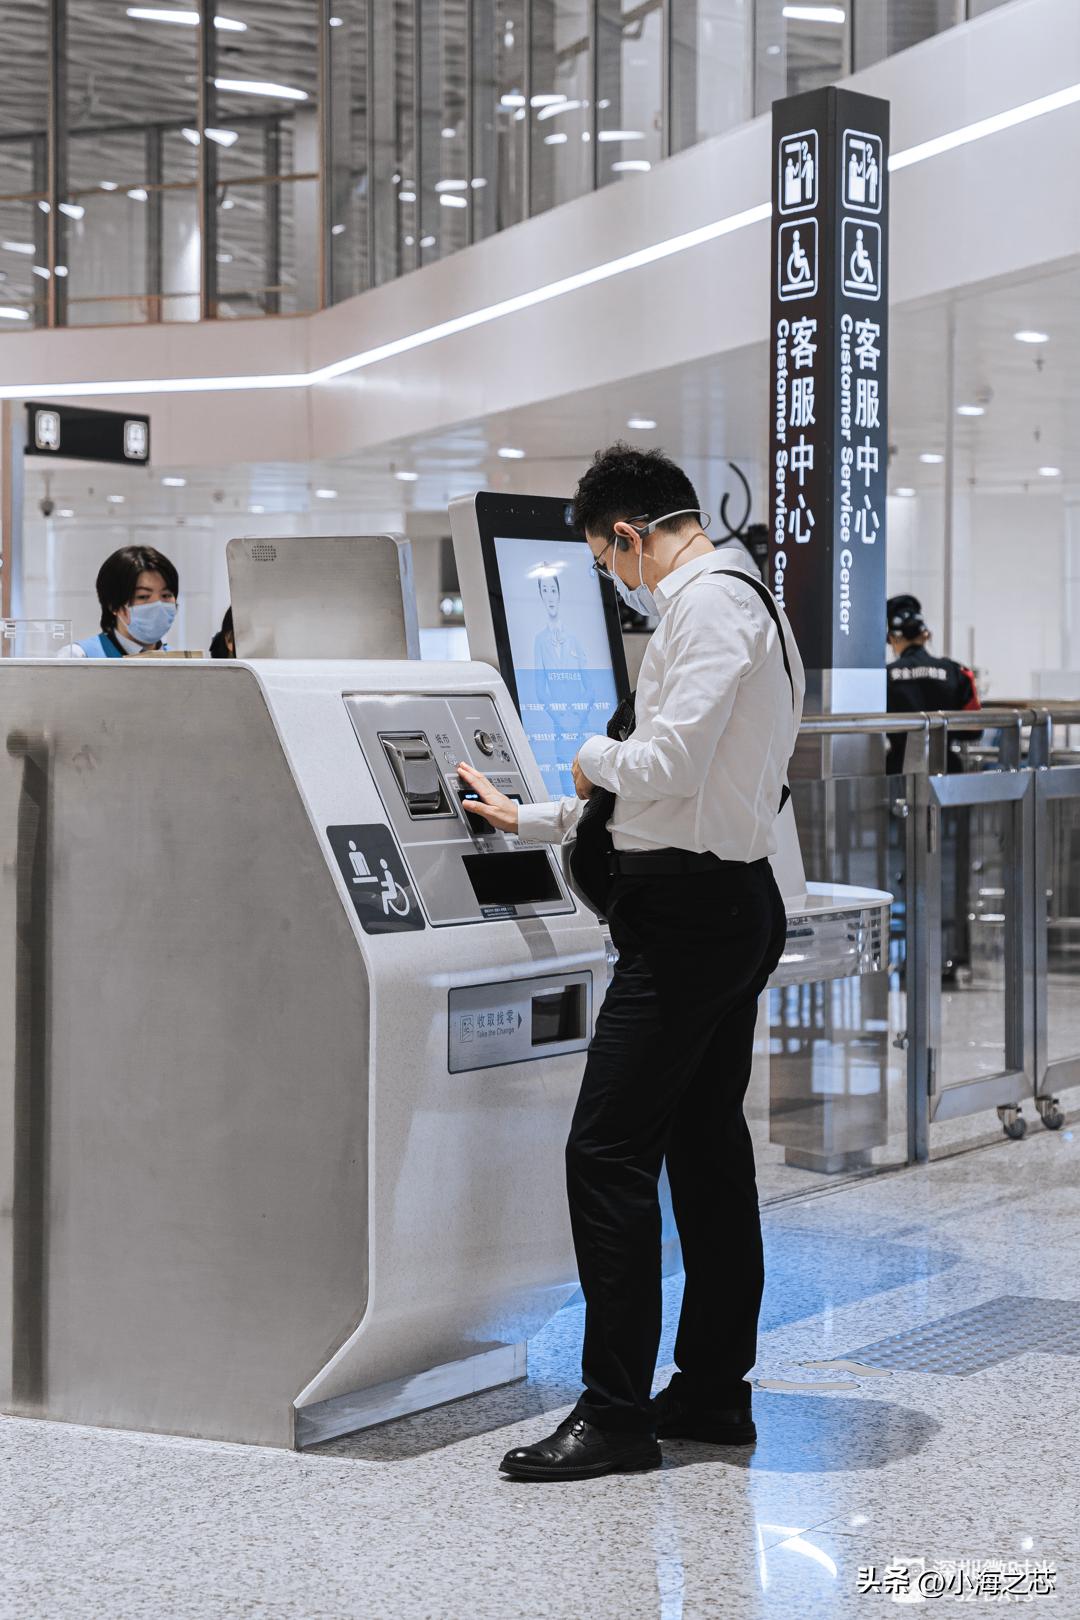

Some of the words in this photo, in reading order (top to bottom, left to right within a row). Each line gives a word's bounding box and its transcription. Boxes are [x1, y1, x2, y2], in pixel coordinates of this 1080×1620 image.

[776, 318, 790, 444] Customer
[840, 313, 853, 442] Customer
[788, 315, 818, 545] 客服中心
[854, 317, 880, 545] 客服中心
[774, 449, 788, 545] Service
[840, 446, 853, 543] Service
[774, 550, 787, 609] Cent
[840, 549, 853, 636] Center
[477, 1010, 514, 1028] 收取找零
